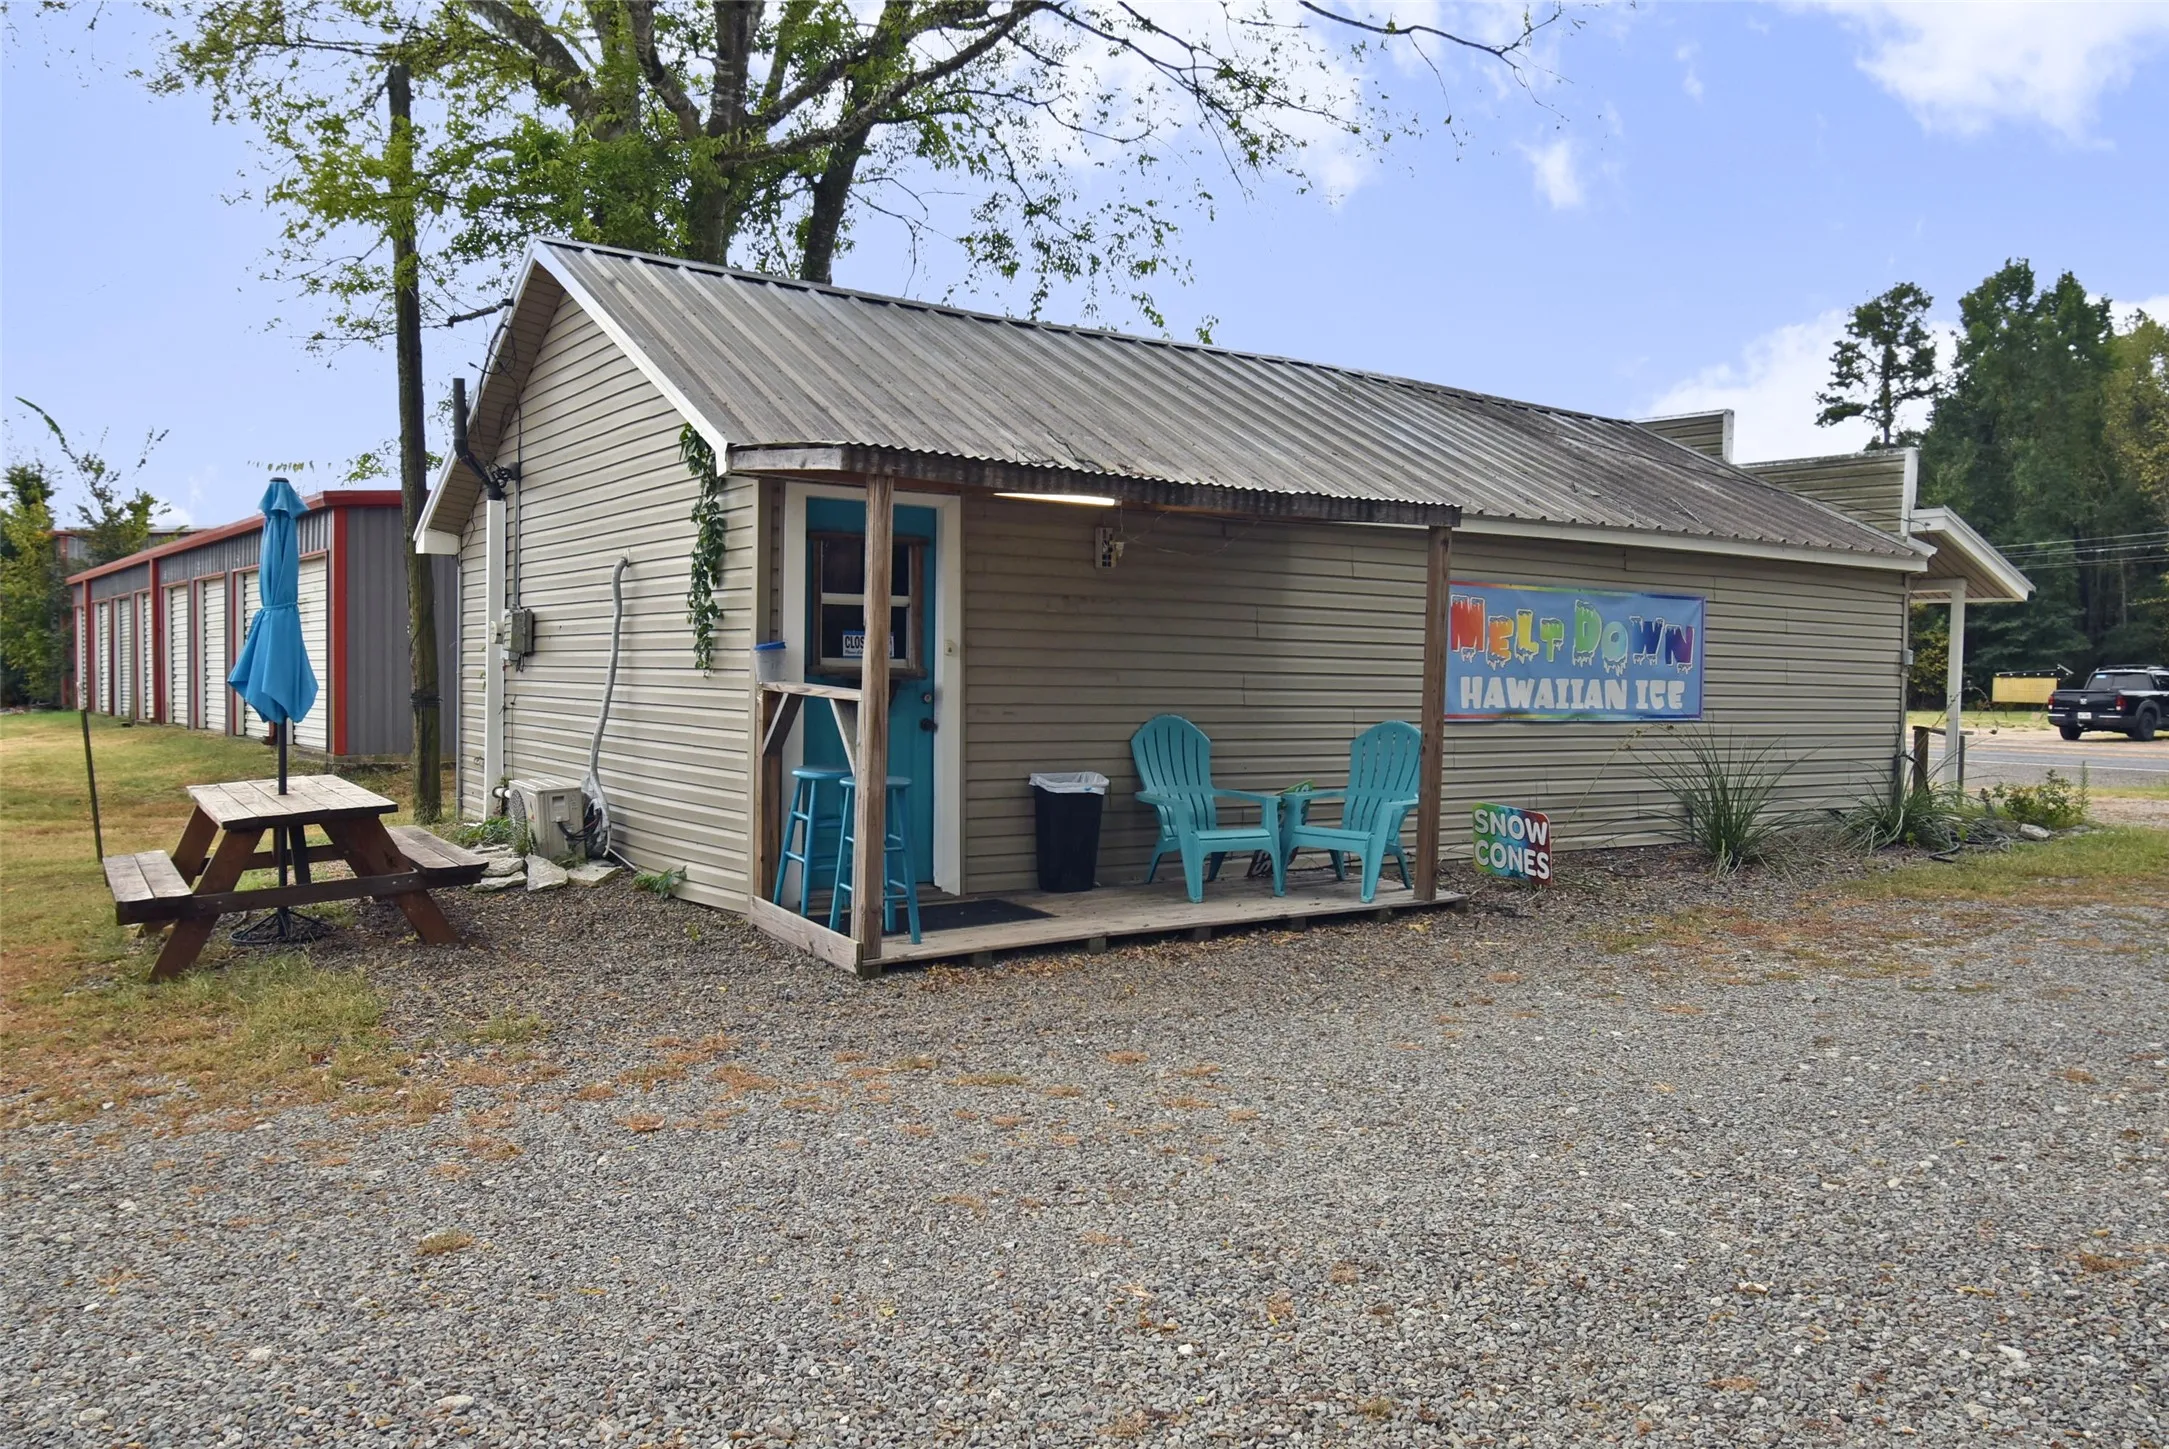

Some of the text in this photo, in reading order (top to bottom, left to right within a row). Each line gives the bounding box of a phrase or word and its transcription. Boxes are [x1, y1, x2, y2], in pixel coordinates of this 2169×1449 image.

[1460, 676, 1686, 710] HAWAIIAN ICE
[1474, 809, 1547, 846] SNOW
[1475, 840, 1550, 880] CONES
